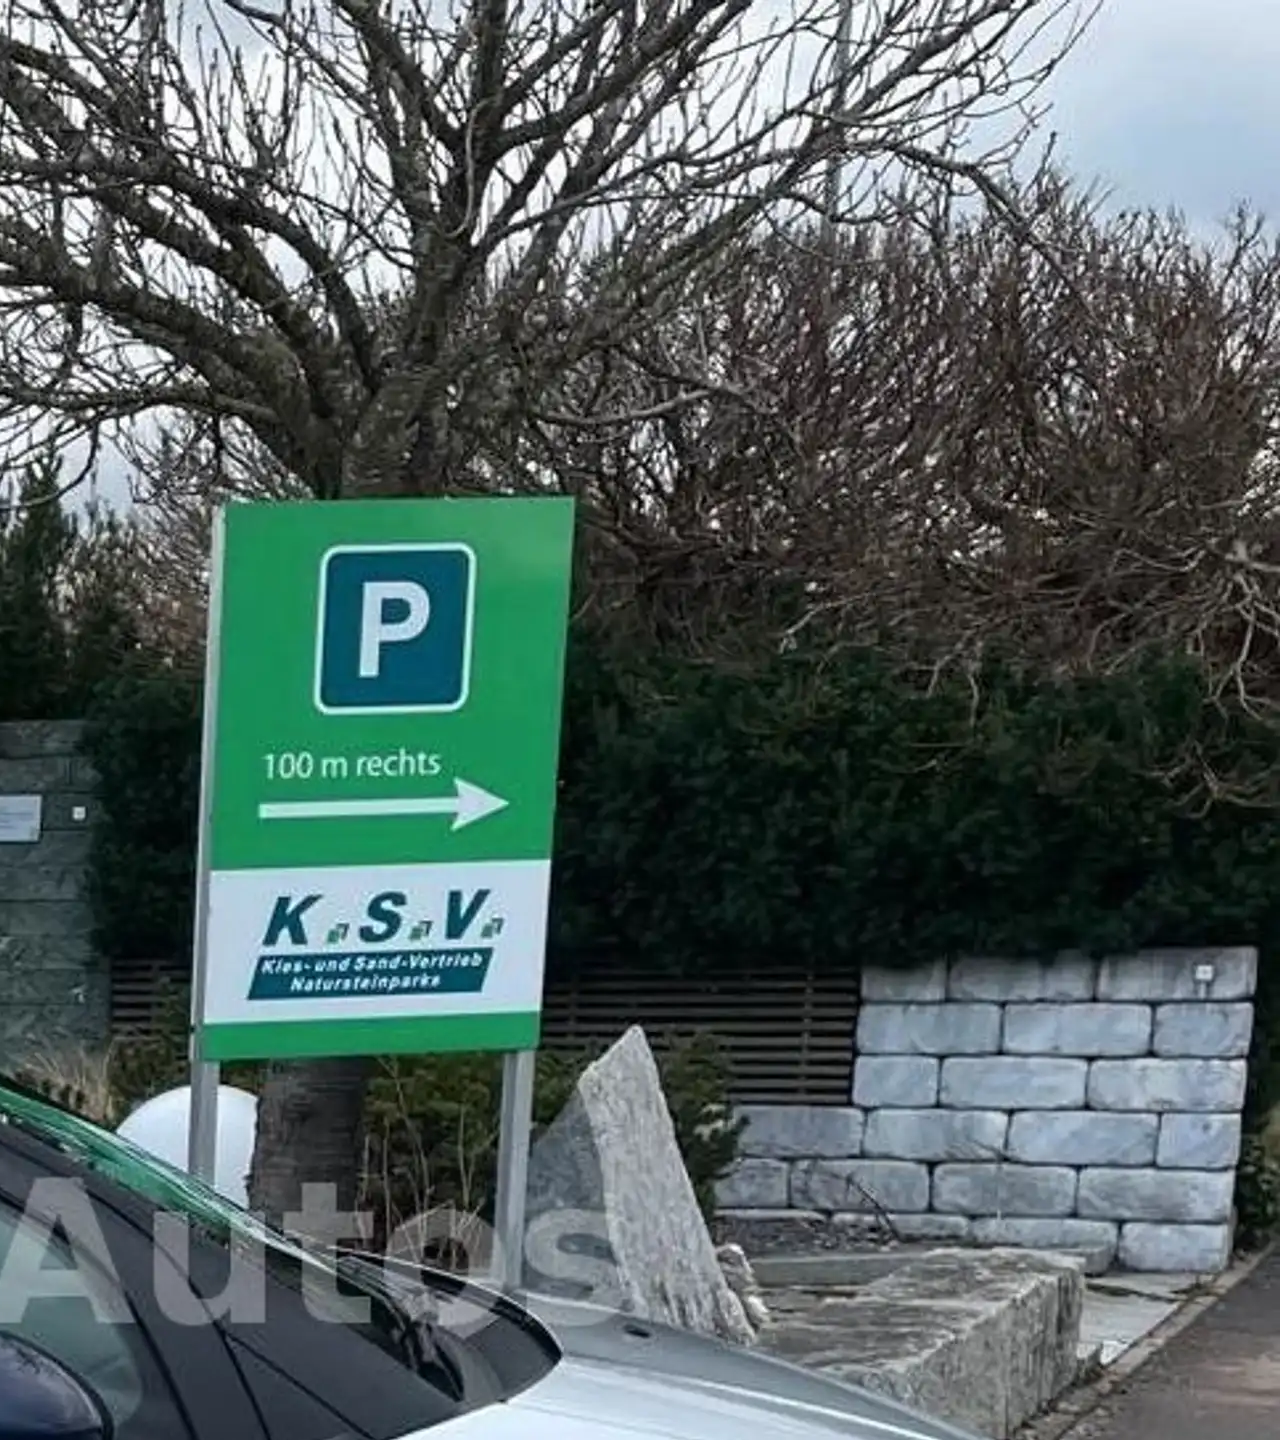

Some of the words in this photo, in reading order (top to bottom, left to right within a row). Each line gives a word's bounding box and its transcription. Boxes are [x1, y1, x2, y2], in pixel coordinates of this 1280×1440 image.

[358, 580, 431, 678] P
[262, 751, 314, 780] 100
[321, 756, 348, 778] m
[356, 747, 442, 777] rechts
[315, 956, 351, 973] und
